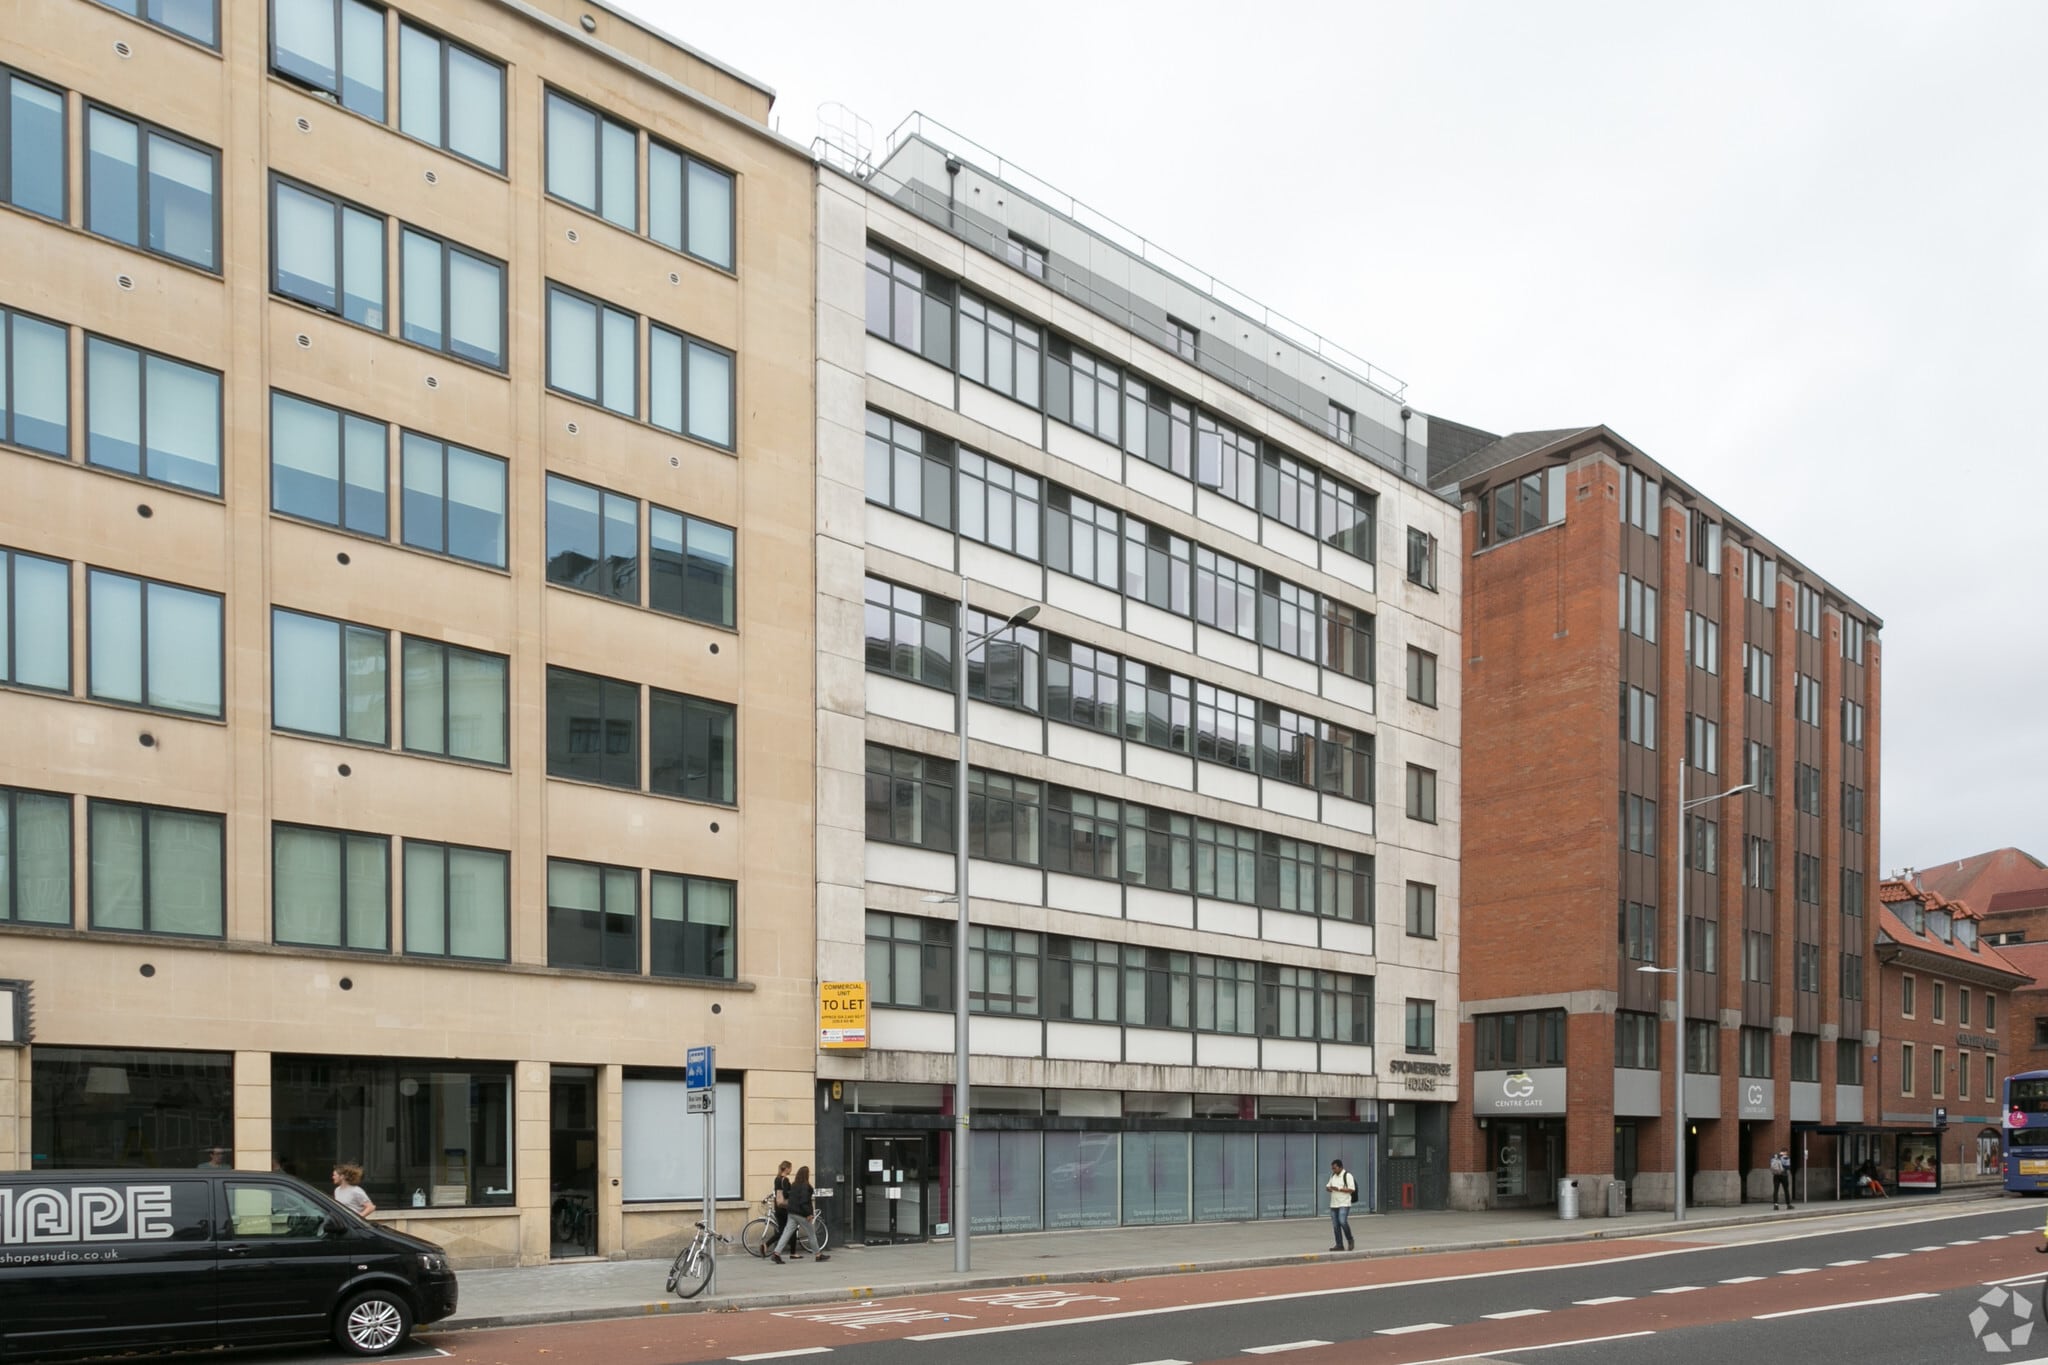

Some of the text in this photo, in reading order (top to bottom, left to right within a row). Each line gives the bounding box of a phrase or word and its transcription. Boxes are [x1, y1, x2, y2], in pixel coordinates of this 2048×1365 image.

[823, 1000, 864, 1010] TO LET
[1390, 1060, 1452, 1076] STONEBRIDGE
[1404, 1076, 1436, 1091] HOUSE
